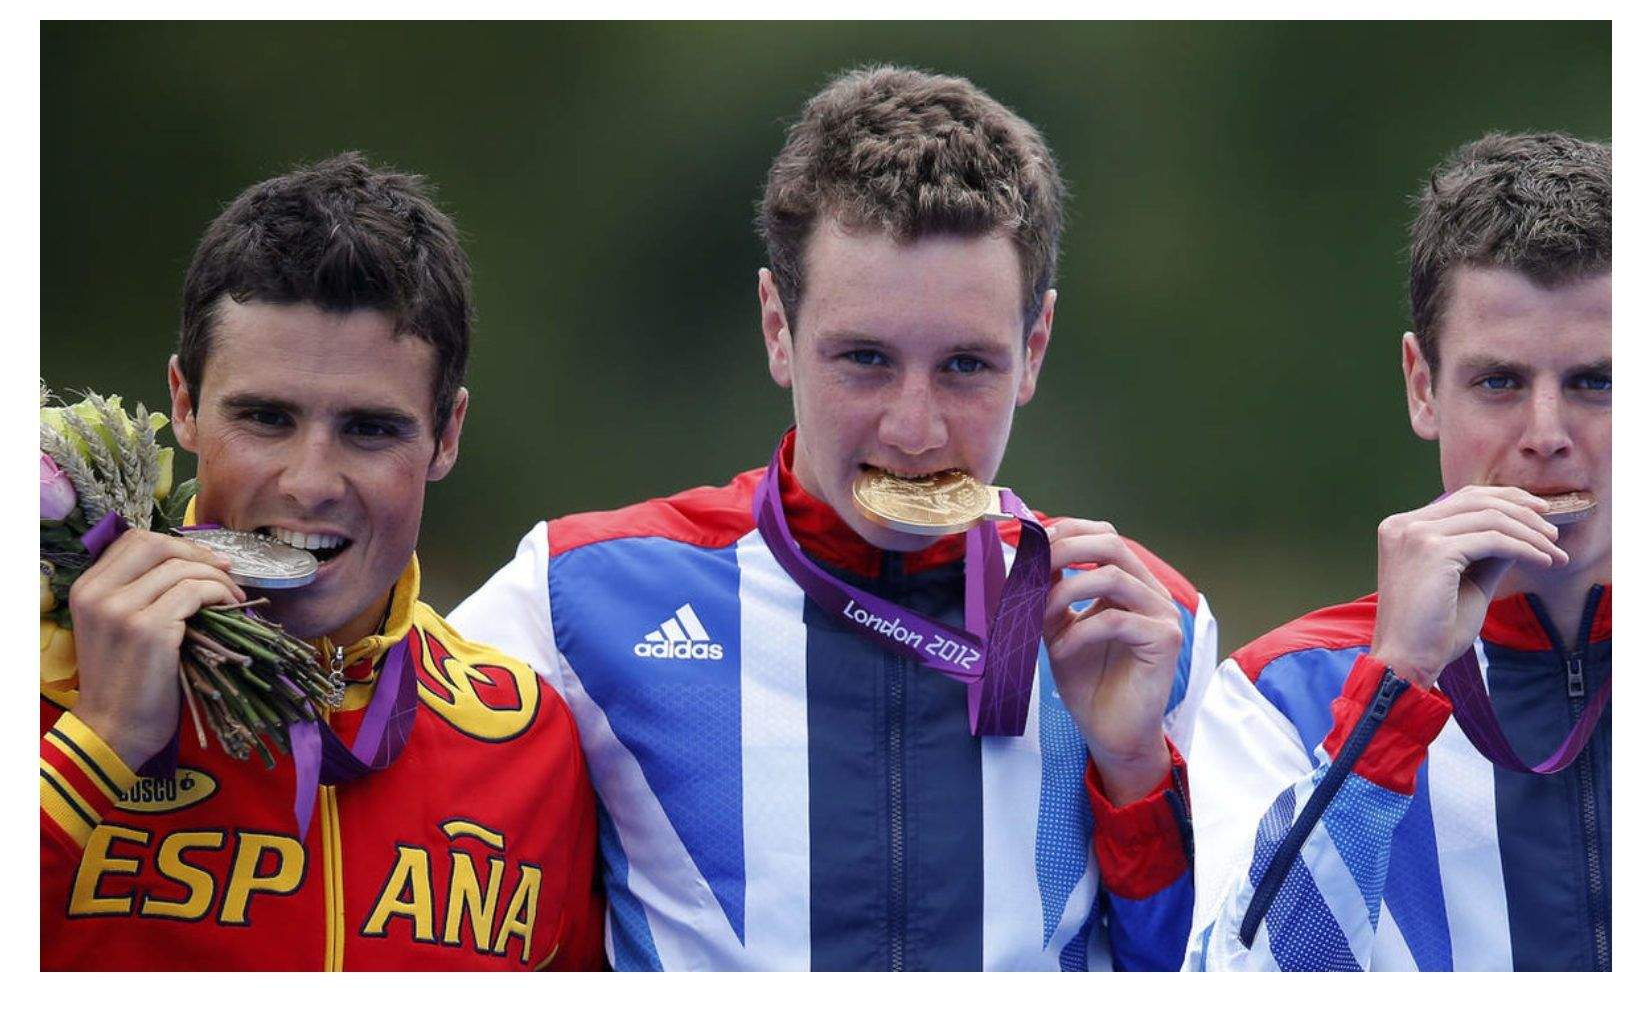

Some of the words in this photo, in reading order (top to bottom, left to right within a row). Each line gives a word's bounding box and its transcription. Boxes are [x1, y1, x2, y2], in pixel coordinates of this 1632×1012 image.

[634, 639, 724, 660] adidas
[843, 599, 924, 649] London
[925, 634, 981, 670] 2012
